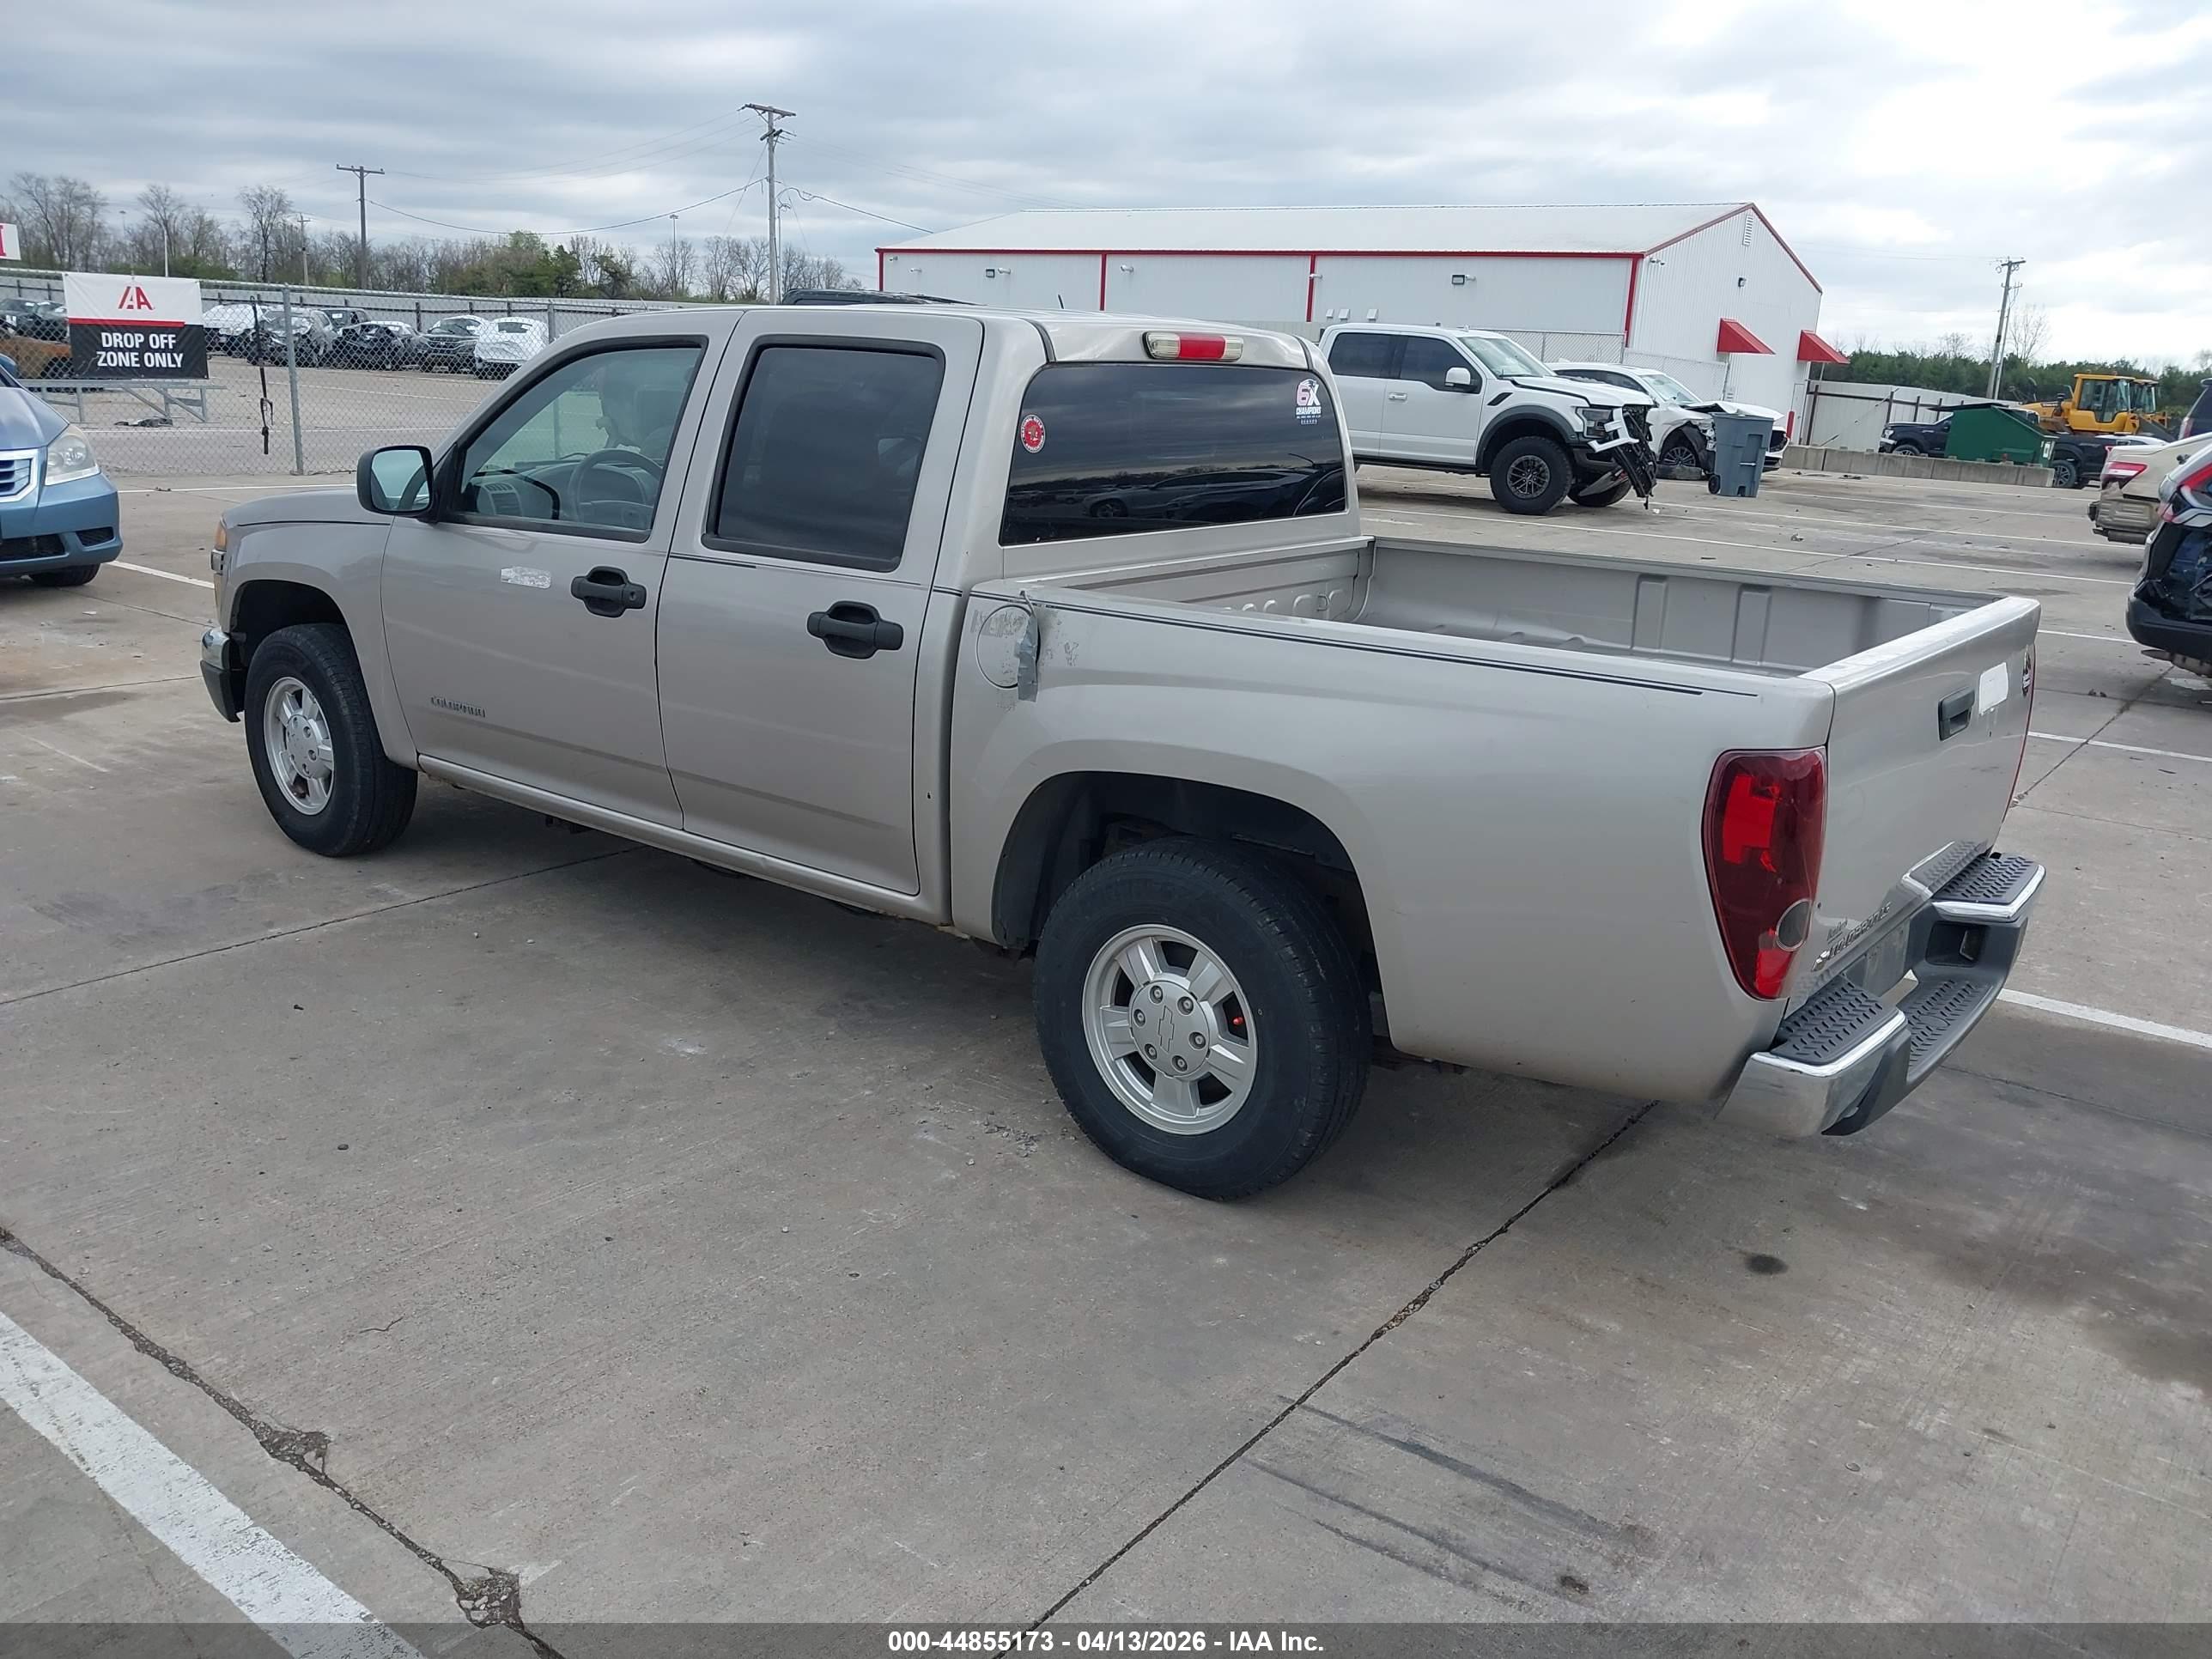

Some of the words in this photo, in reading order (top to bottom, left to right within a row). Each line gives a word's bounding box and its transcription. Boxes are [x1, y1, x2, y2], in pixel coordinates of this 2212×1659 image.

[101, 332, 144, 349] DROP
[149, 333, 177, 349] OFF
[96, 351, 141, 368] ZONE
[144, 352, 184, 368] ONLY
